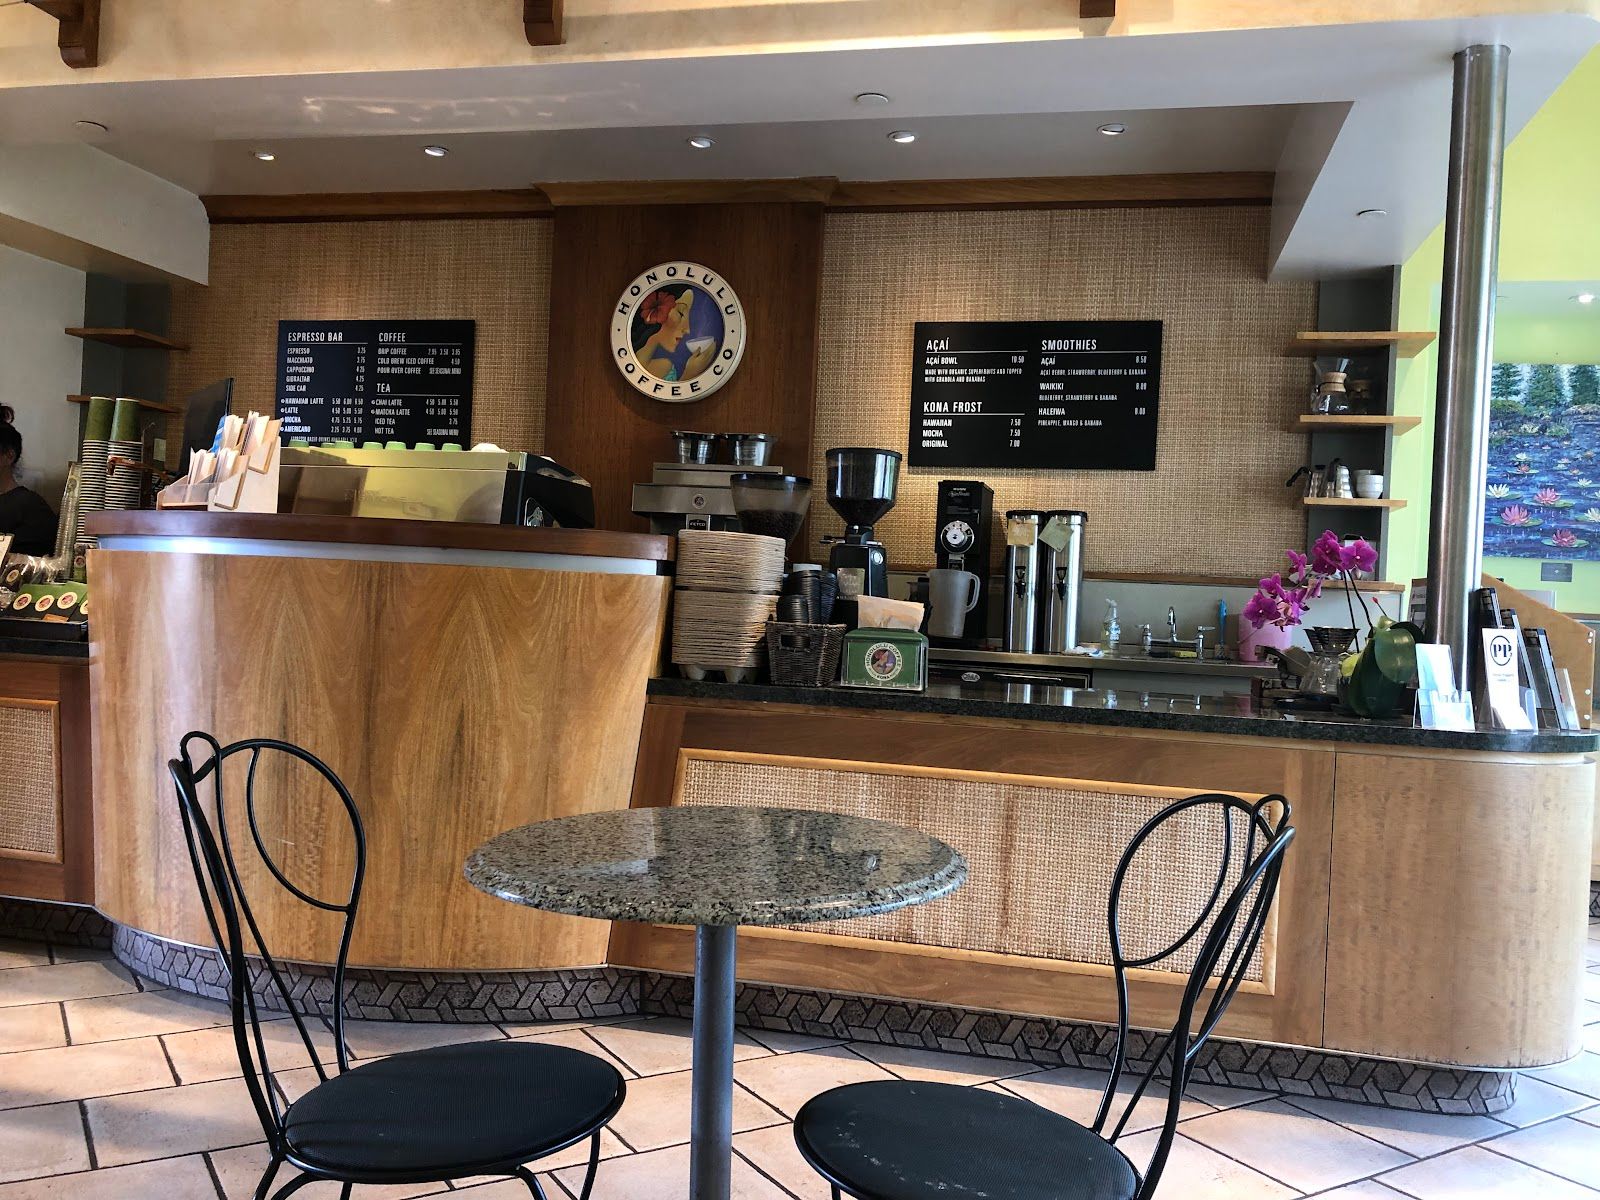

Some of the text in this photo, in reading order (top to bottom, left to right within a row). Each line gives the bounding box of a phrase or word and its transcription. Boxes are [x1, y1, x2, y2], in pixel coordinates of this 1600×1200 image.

[618, 267, 735, 315] HONOLULU
[288, 332, 343, 342] ESPRESSO BAR
[378, 332, 406, 342] COFFEE
[926, 336, 950, 352] AÇAÍ
[1042, 340, 1097, 350] SMOOTHIES
[926, 355, 940, 366] AÇAÍ
[940, 356, 958, 364] BOWL
[618, 348, 732, 396] COFFEE CO
[377, 383, 390, 392] TEA
[1040, 382, 1064, 390] WAIKIKI
[923, 402, 982, 412] KONA FROST
[1038, 408, 1066, 416] HALEIWA
[922, 418, 952, 426] HAWAIIAN
[922, 429, 944, 437] MOCHA
[922, 440, 948, 448] ORIGINAL
